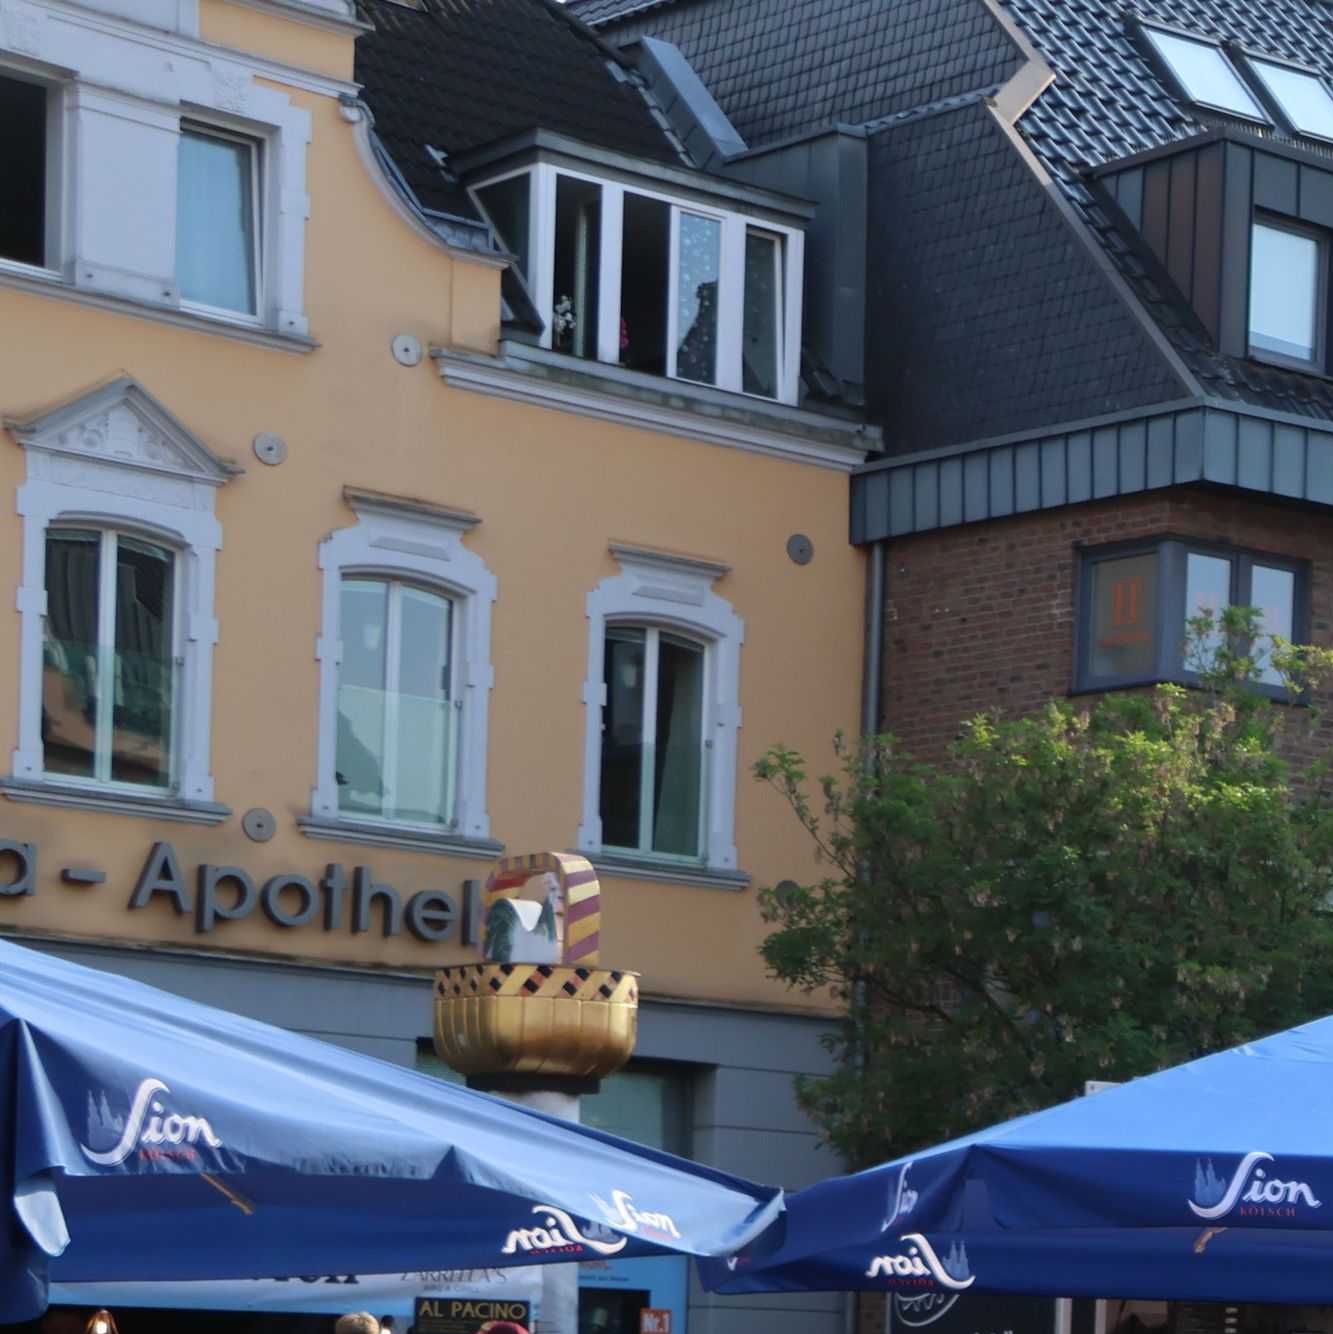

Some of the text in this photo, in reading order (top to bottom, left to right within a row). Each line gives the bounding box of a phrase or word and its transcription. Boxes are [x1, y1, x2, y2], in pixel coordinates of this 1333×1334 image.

[80, 1078, 223, 1166] Sion
[1187, 1151, 1322, 1220] Sion
[420, 1301, 527, 1320] AL PACINO
